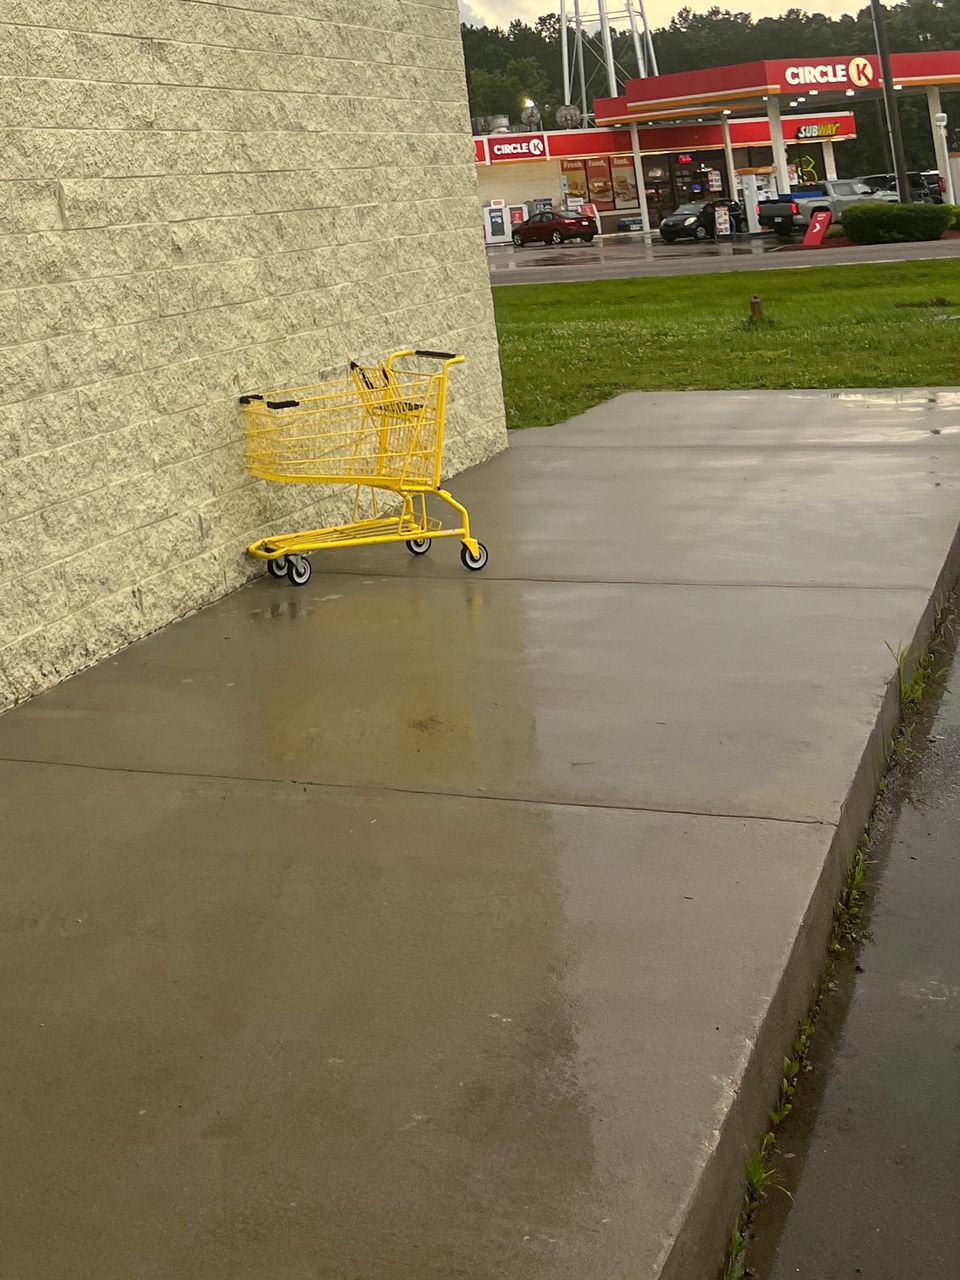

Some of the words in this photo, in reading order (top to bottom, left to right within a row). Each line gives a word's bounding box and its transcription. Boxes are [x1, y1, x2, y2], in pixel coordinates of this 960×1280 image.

[785, 64, 847, 85] CIRCLE
[798, 122, 840, 138] SUBWAY
[493, 142, 529, 155] CIRCLE
